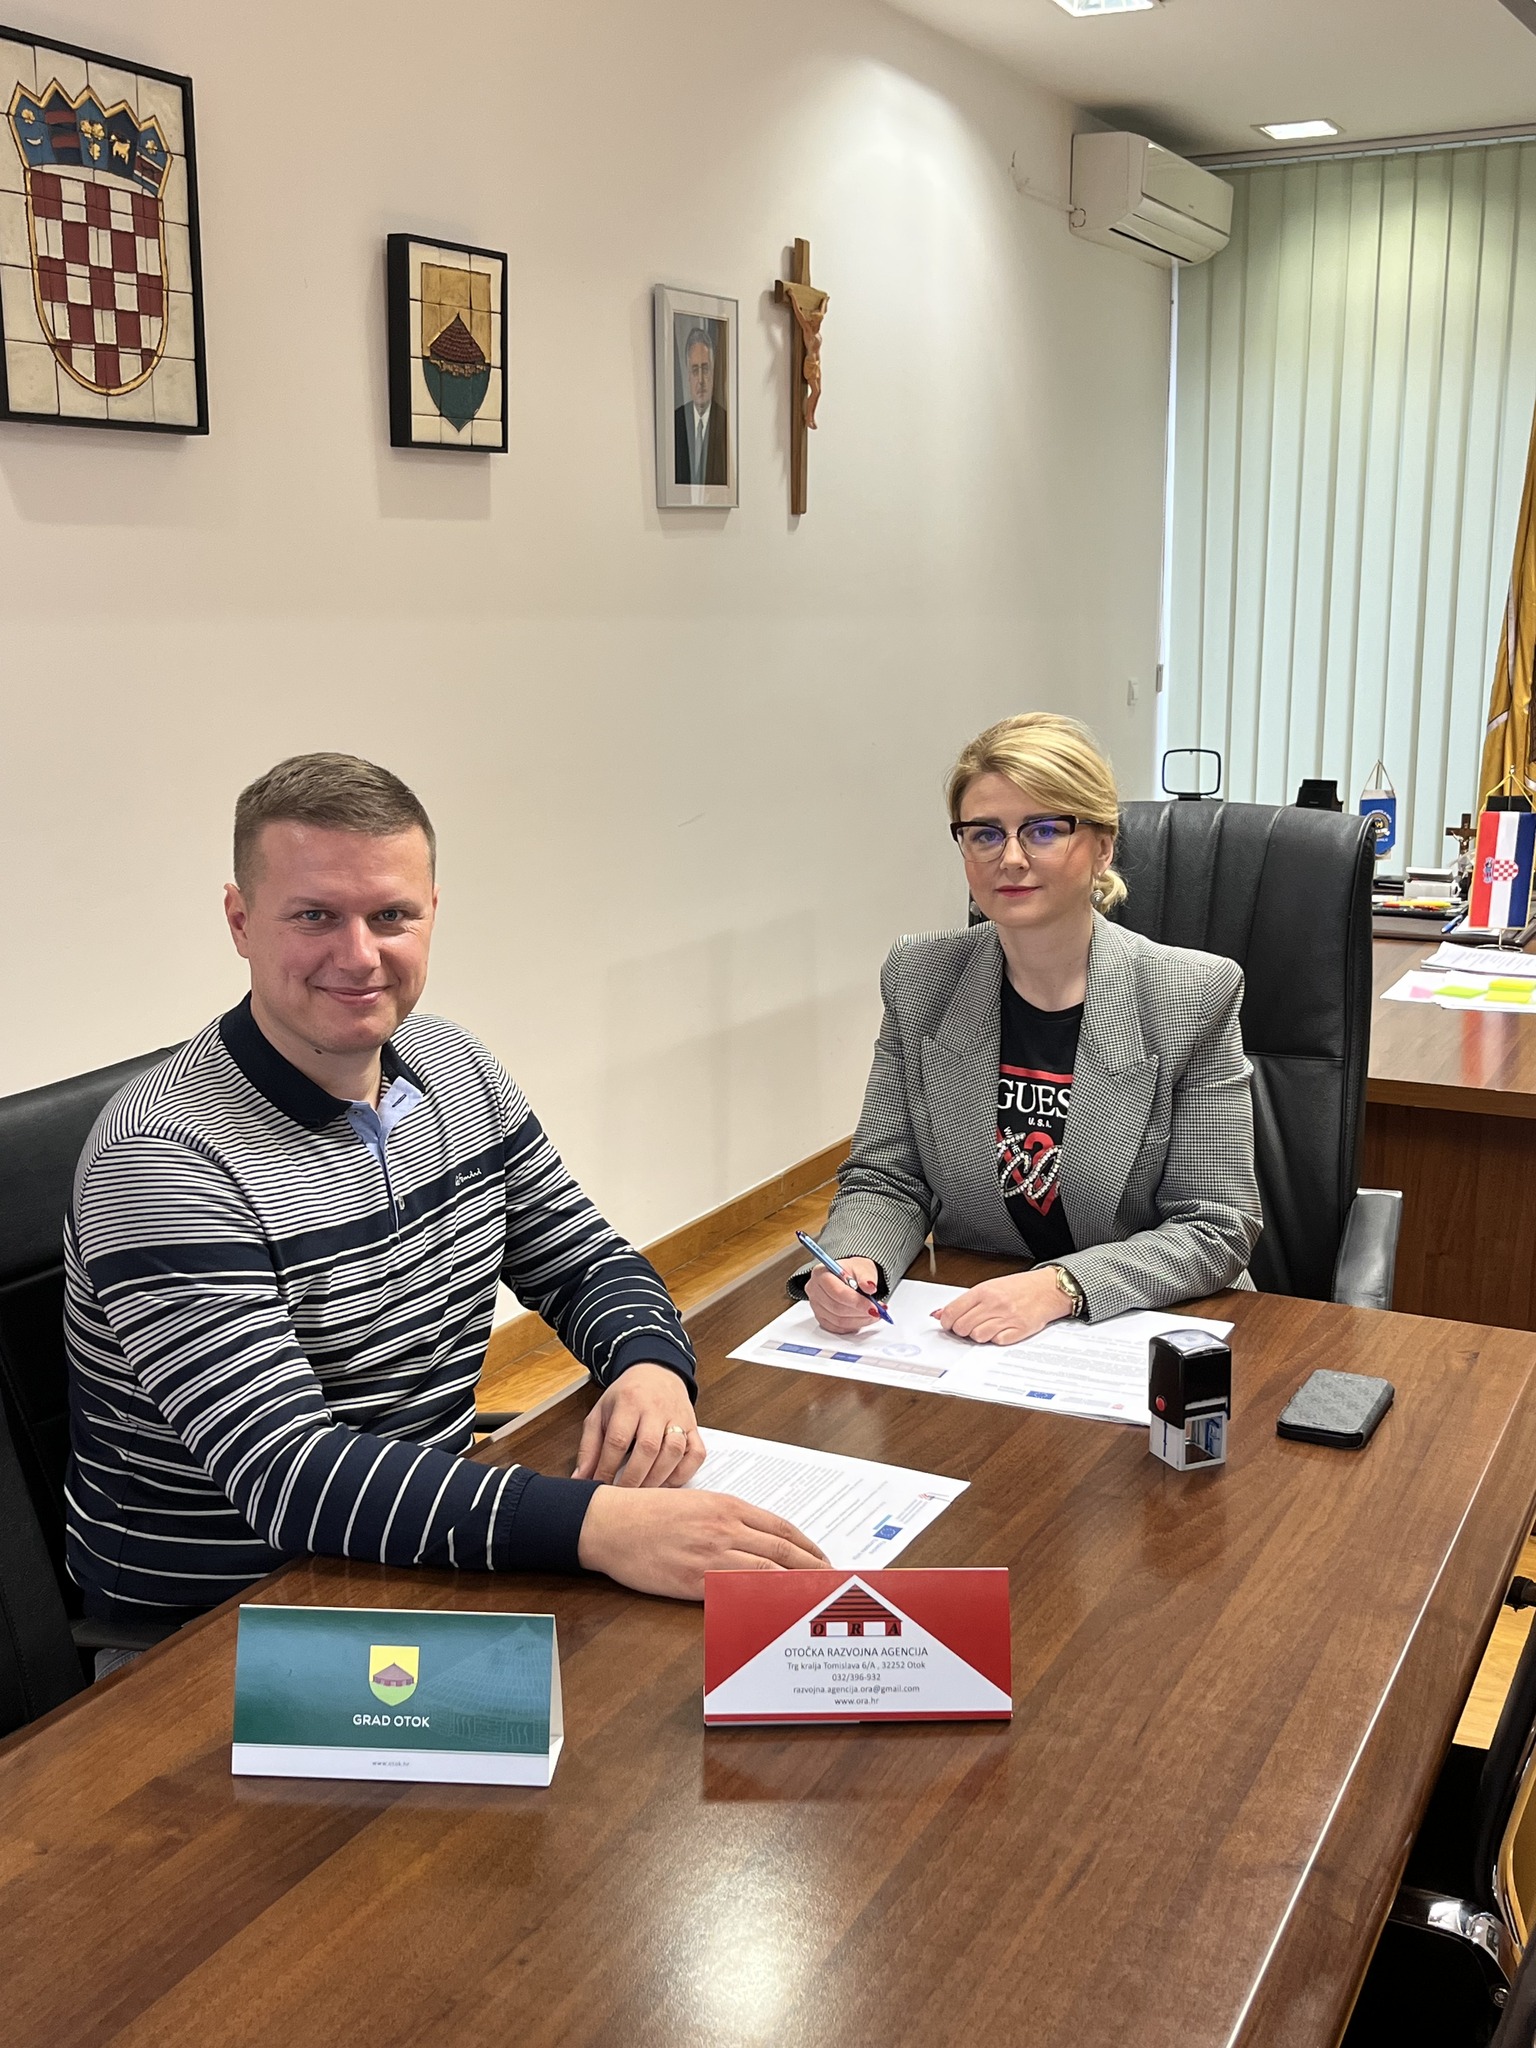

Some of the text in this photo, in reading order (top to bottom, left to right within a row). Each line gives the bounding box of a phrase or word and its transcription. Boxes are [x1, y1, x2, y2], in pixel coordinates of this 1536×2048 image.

[784, 1646, 929, 1658] OTOČKA RAZVOJNA AGENCIJA
[788, 1662, 799, 1672] Trg
[801, 1661, 822, 1672] kralja
[824, 1661, 860, 1670] Tomislava
[882, 1661, 905, 1670] 32252
[907, 1661, 926, 1669] Otok
[832, 1673, 881, 1682] 032/396-932
[793, 1684, 920, 1695] razvojna.agencija.ora@gmail.com
[834, 1697, 880, 1705] www.ora.hr
[353, 1714, 430, 1728] GRAD OTOK
